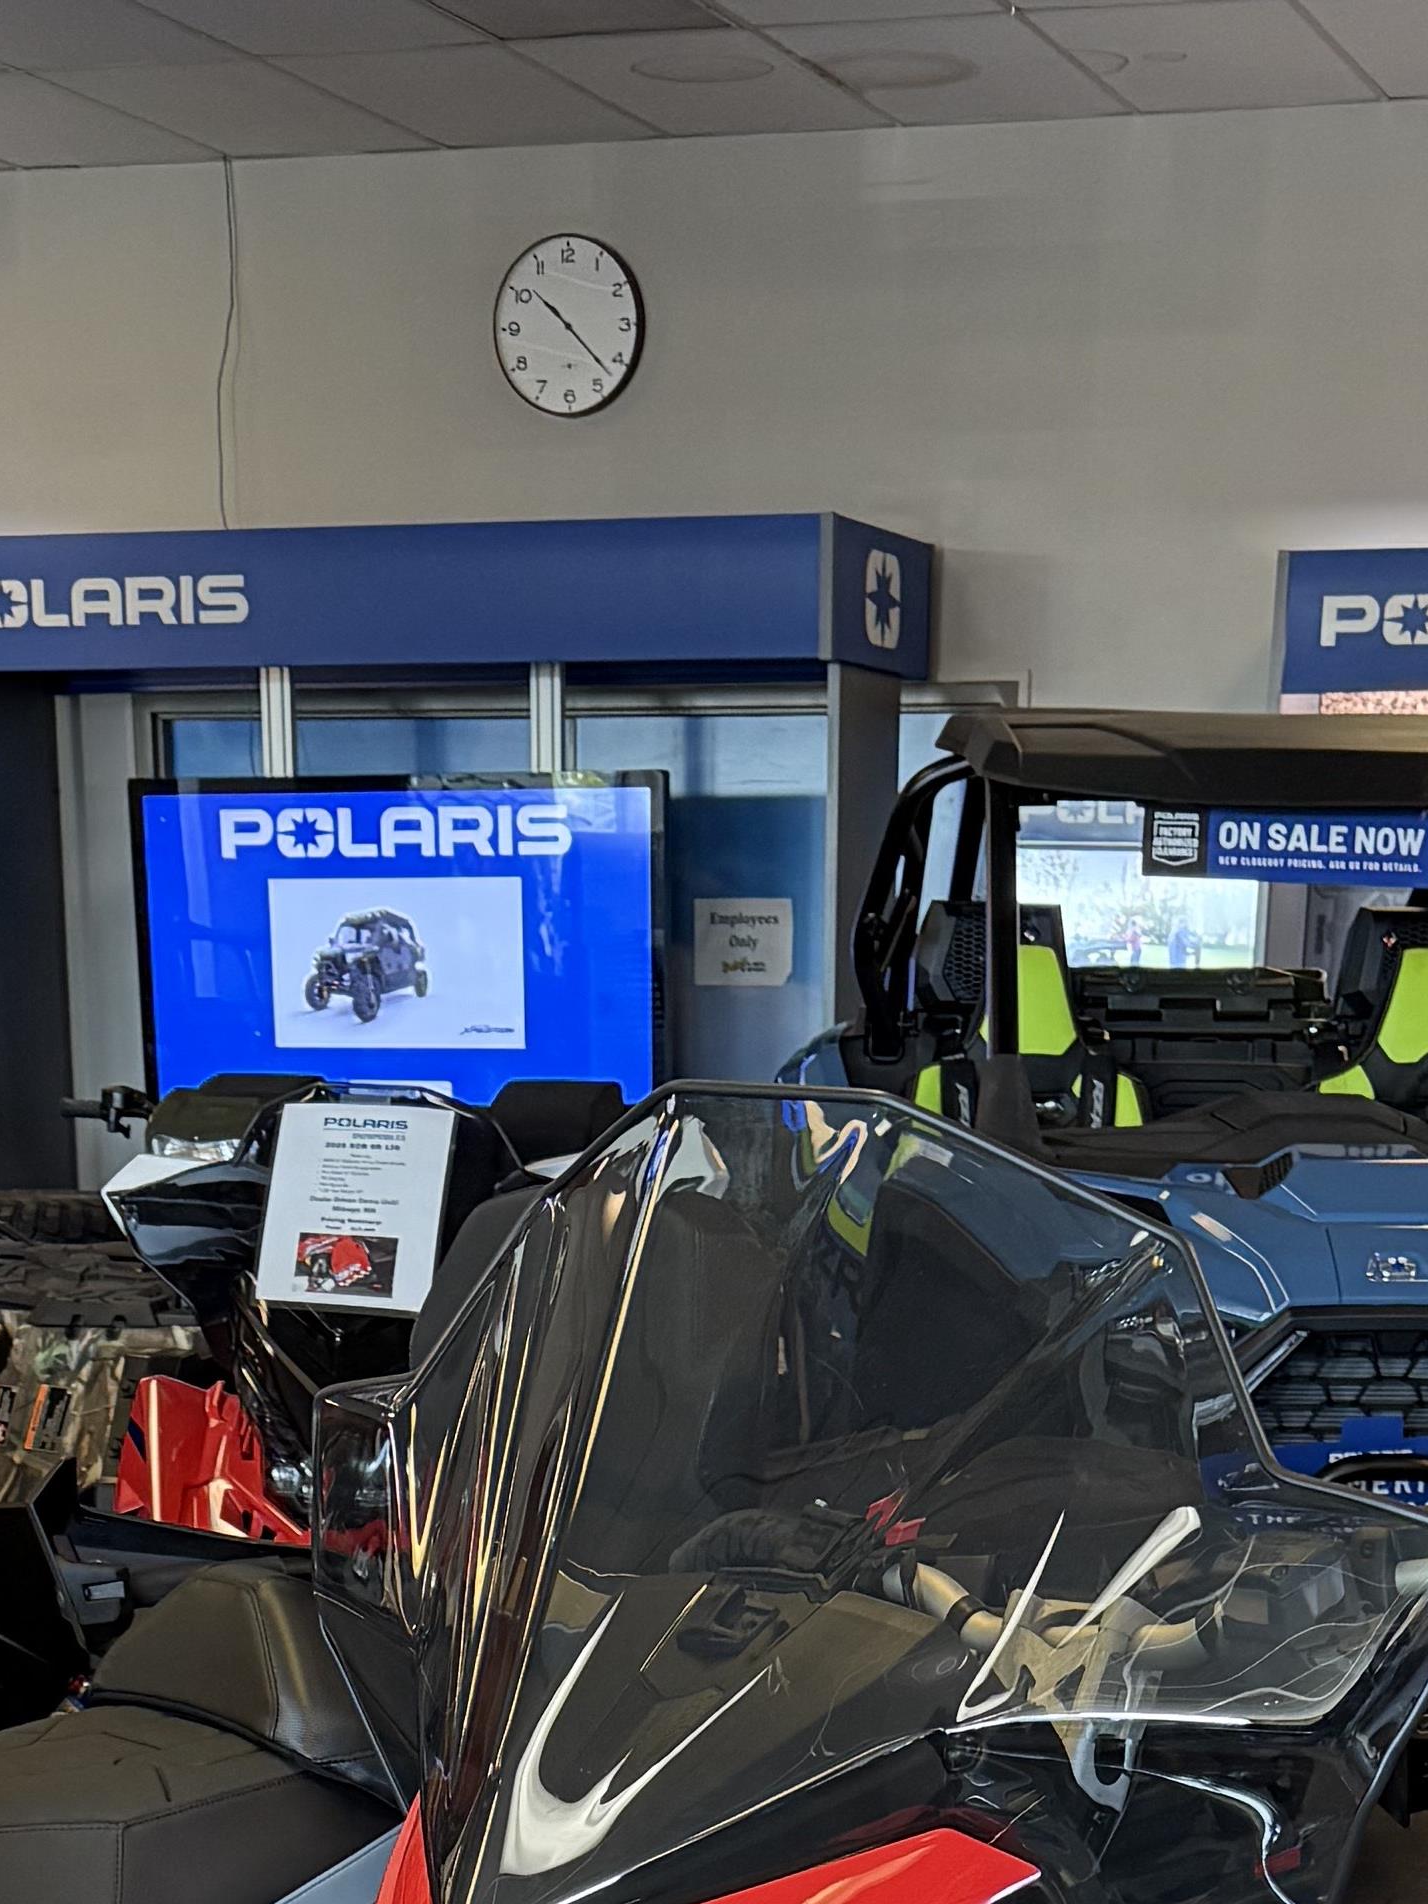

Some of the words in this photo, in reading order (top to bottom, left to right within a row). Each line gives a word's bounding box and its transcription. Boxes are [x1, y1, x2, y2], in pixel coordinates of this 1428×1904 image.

[560, 248, 576, 264] 12
[535, 259, 546, 275] 11
[514, 289, 532, 304] 10
[611, 283, 624, 298] 2
[508, 321, 521, 336] 9
[618, 318, 631, 332] 3
[516, 356, 528, 371] 8
[612, 352, 624, 365] 4
[536, 380, 547, 393] 7
[592, 379, 604, 393] 5
[564, 390, 576, 403] 6
[219, 804, 573, 858] POLARIS
[1218, 820, 1261, 850] ON
[1267, 822, 1348, 853] SALE
[1354, 825, 1426, 857] NOW
[729, 934, 759, 952] Only
[323, 1116, 409, 1130] POLARIS
